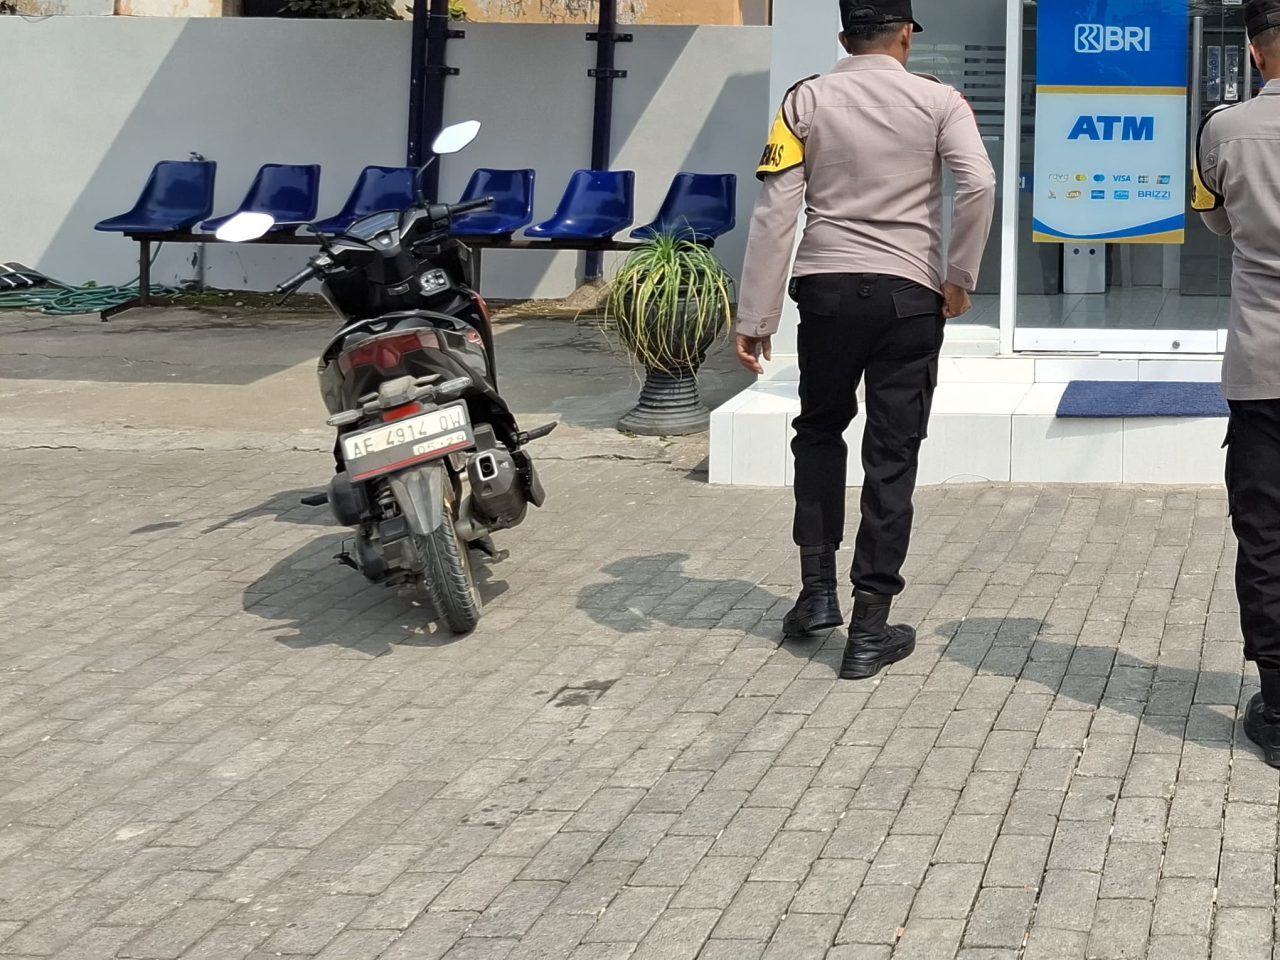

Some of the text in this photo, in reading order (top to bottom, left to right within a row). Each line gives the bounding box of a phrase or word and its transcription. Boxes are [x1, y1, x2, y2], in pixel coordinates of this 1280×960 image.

[1105, 26, 1151, 52] BRI
[1066, 115, 1154, 141] ATM
[1137, 190, 1171, 198] BRIZZI
[386, 421, 427, 446] 4914
